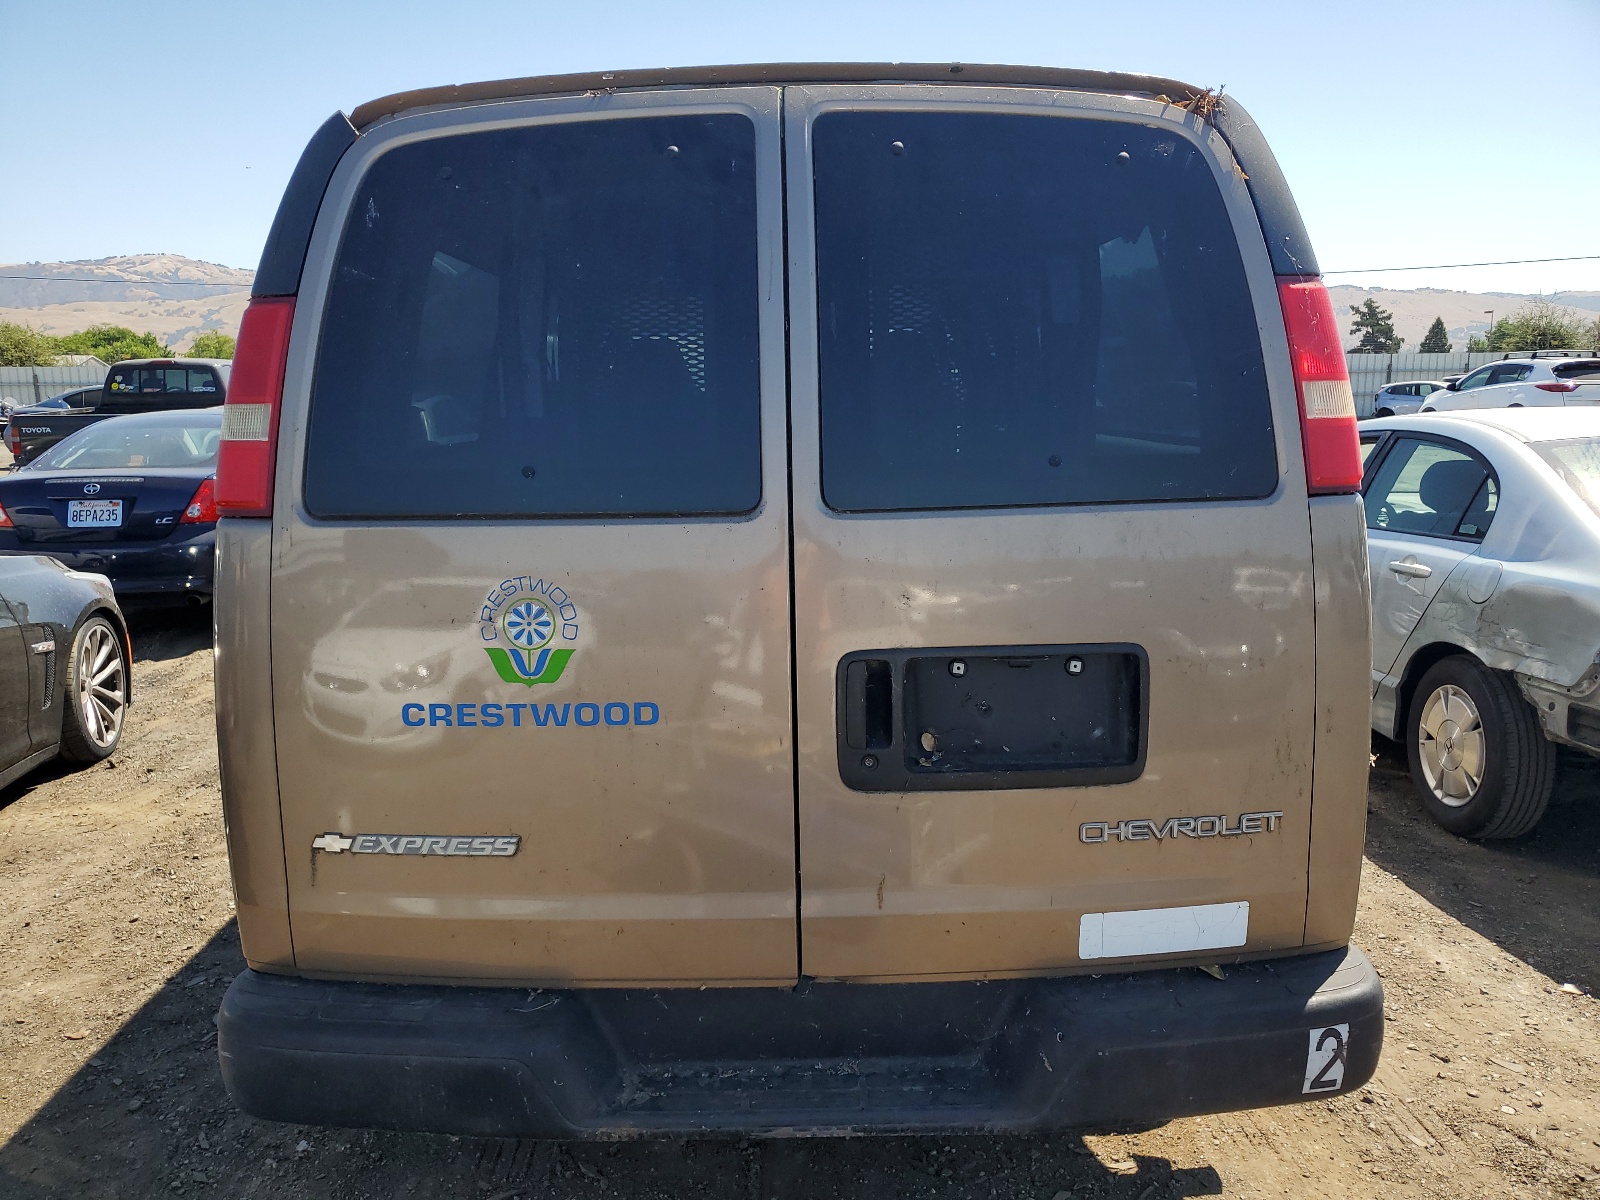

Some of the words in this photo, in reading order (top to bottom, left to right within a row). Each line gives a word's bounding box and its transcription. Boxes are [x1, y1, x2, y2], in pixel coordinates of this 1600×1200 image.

[71, 509, 118, 522] 8EPA235
[480, 575, 579, 641] CRESTWOOD
[401, 701, 660, 728] CRESTWOOD
[1079, 810, 1284, 844] CHEVROLET
[351, 835, 520, 856] EXPRESS
[1309, 1027, 1344, 1090] 2
